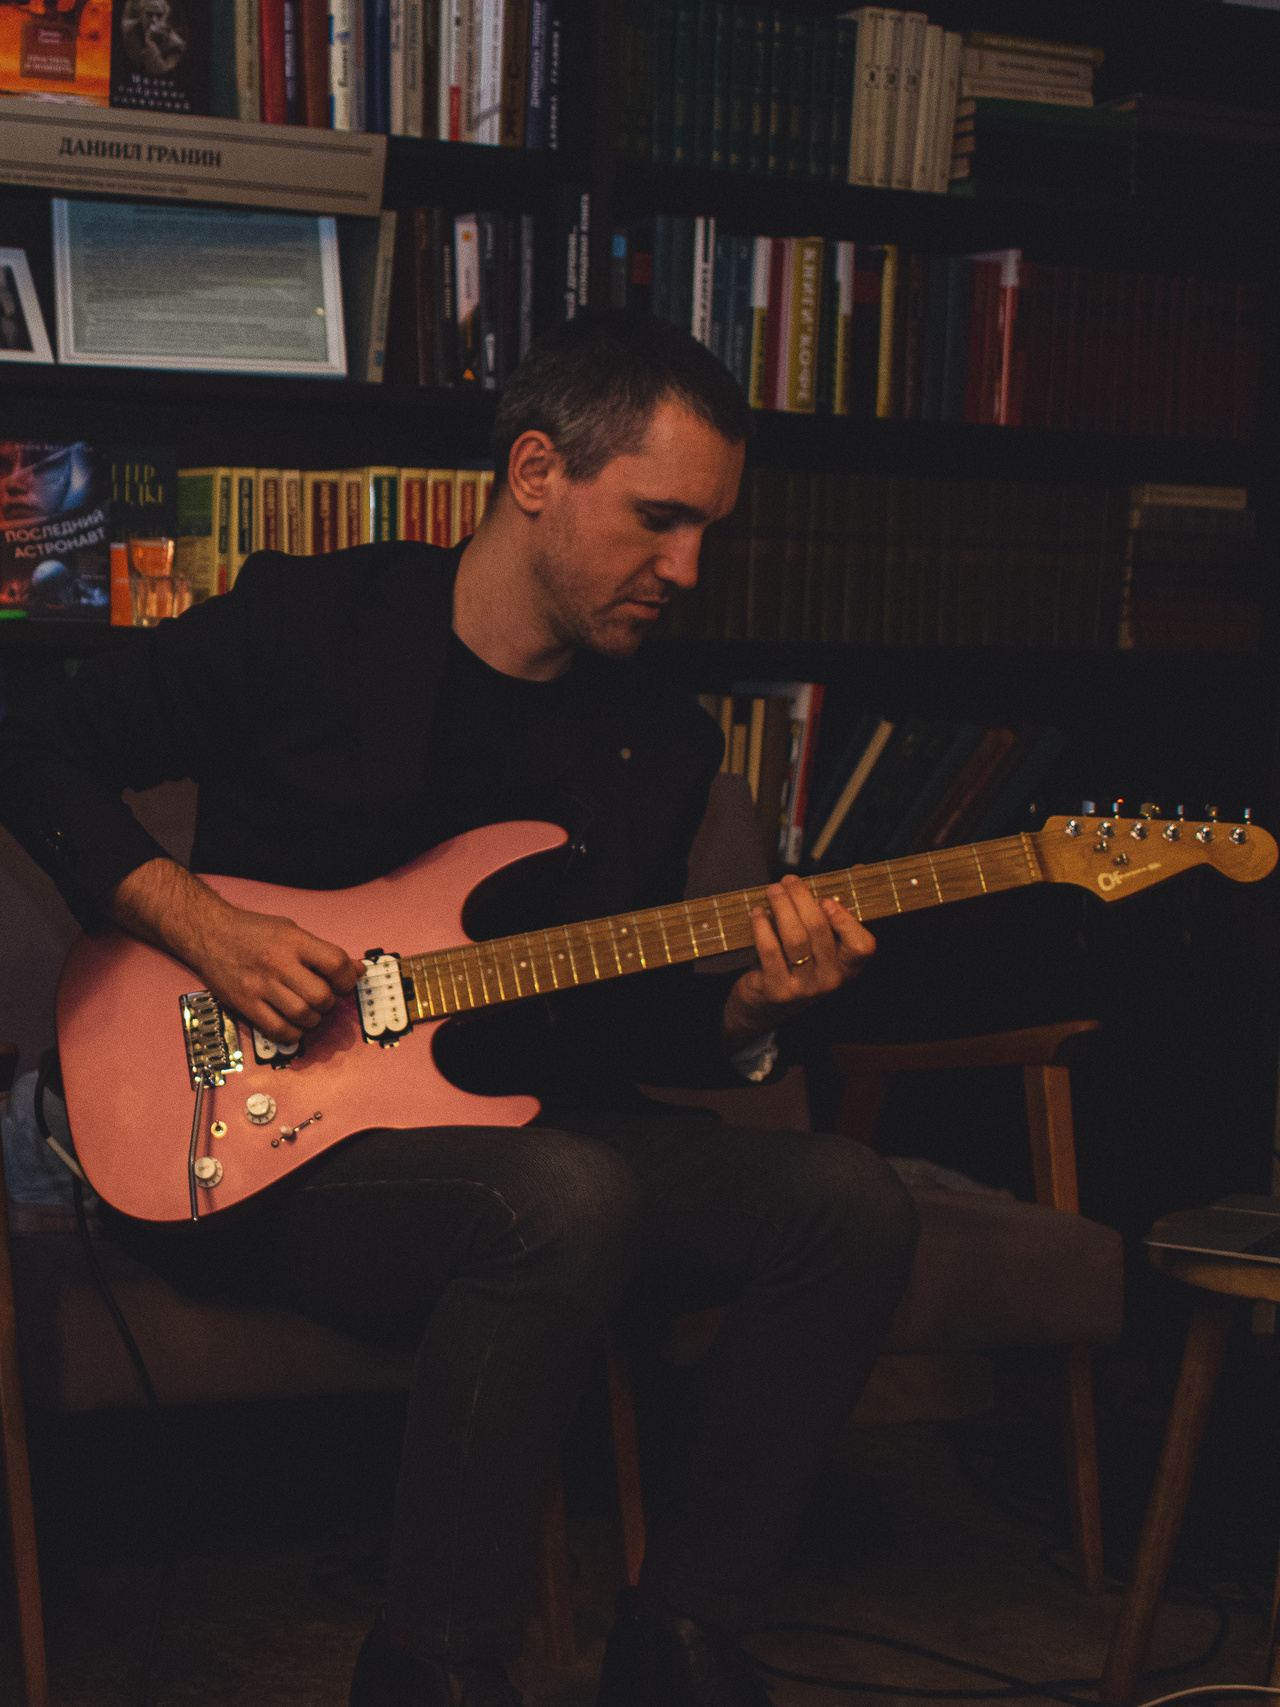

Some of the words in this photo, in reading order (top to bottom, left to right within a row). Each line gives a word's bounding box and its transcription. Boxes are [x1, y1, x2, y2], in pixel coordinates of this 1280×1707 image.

[59, 137, 142, 161] ДАНИИЛ
[146, 144, 222, 168] ГРАНИН
[4, 508, 106, 544] ПОСЛЕДНИЙ
[14, 526, 106, 560] АСТРОНАВТ
